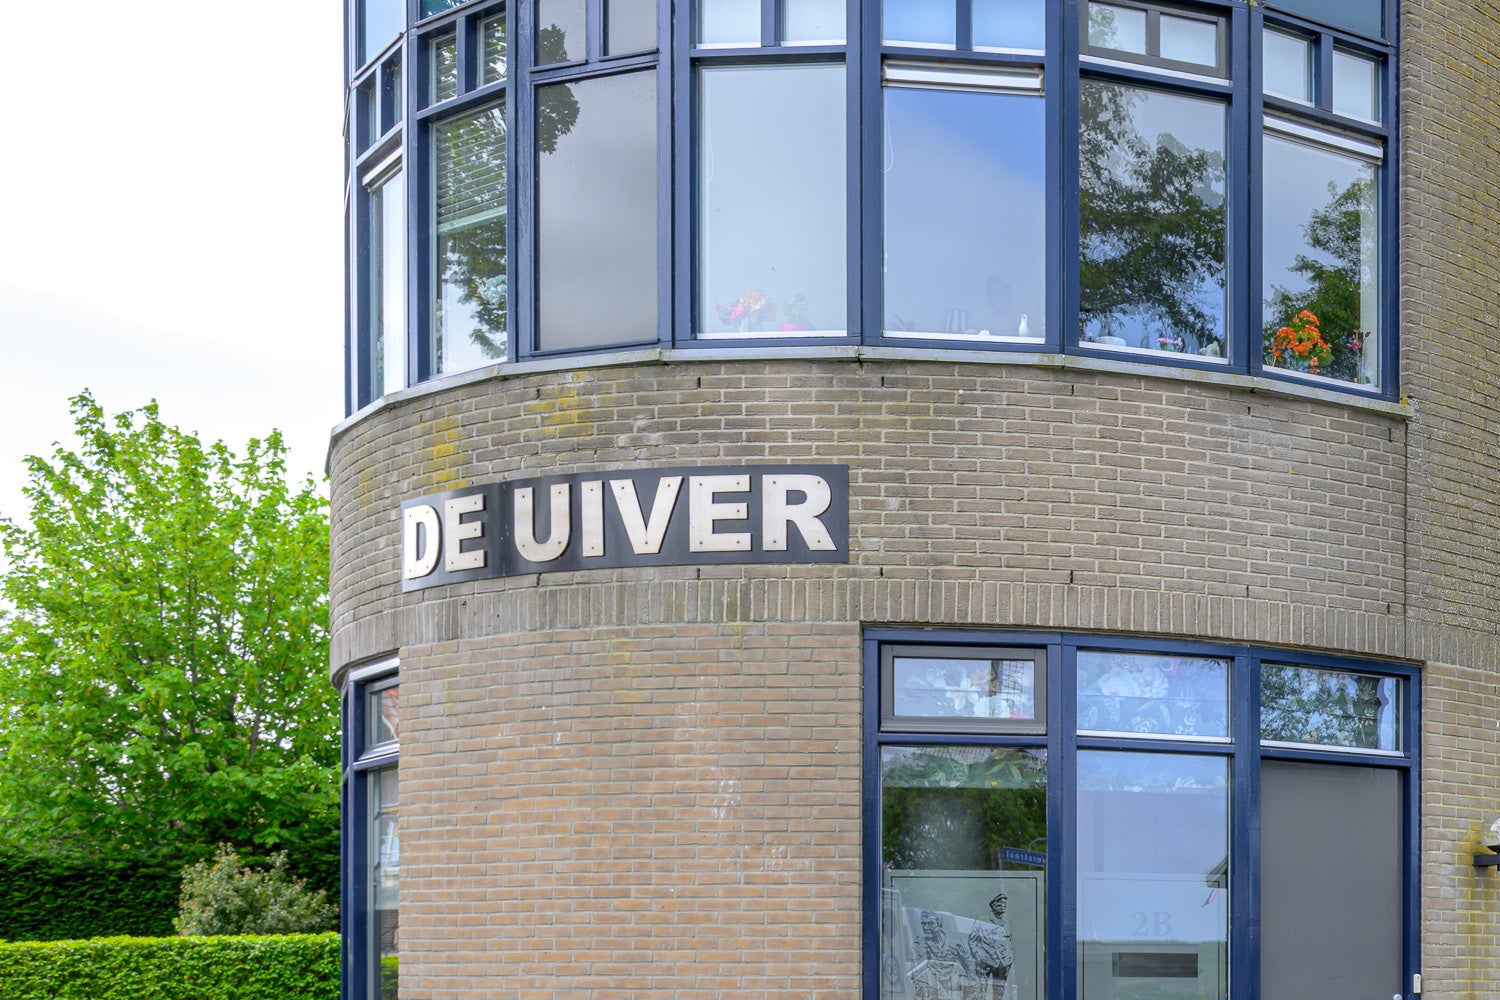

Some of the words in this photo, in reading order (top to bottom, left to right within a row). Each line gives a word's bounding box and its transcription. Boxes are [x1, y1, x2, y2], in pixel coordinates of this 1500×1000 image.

[402, 493, 487, 580] DE
[513, 474, 838, 563] UIVER
[1132, 911, 1173, 937] 2B
